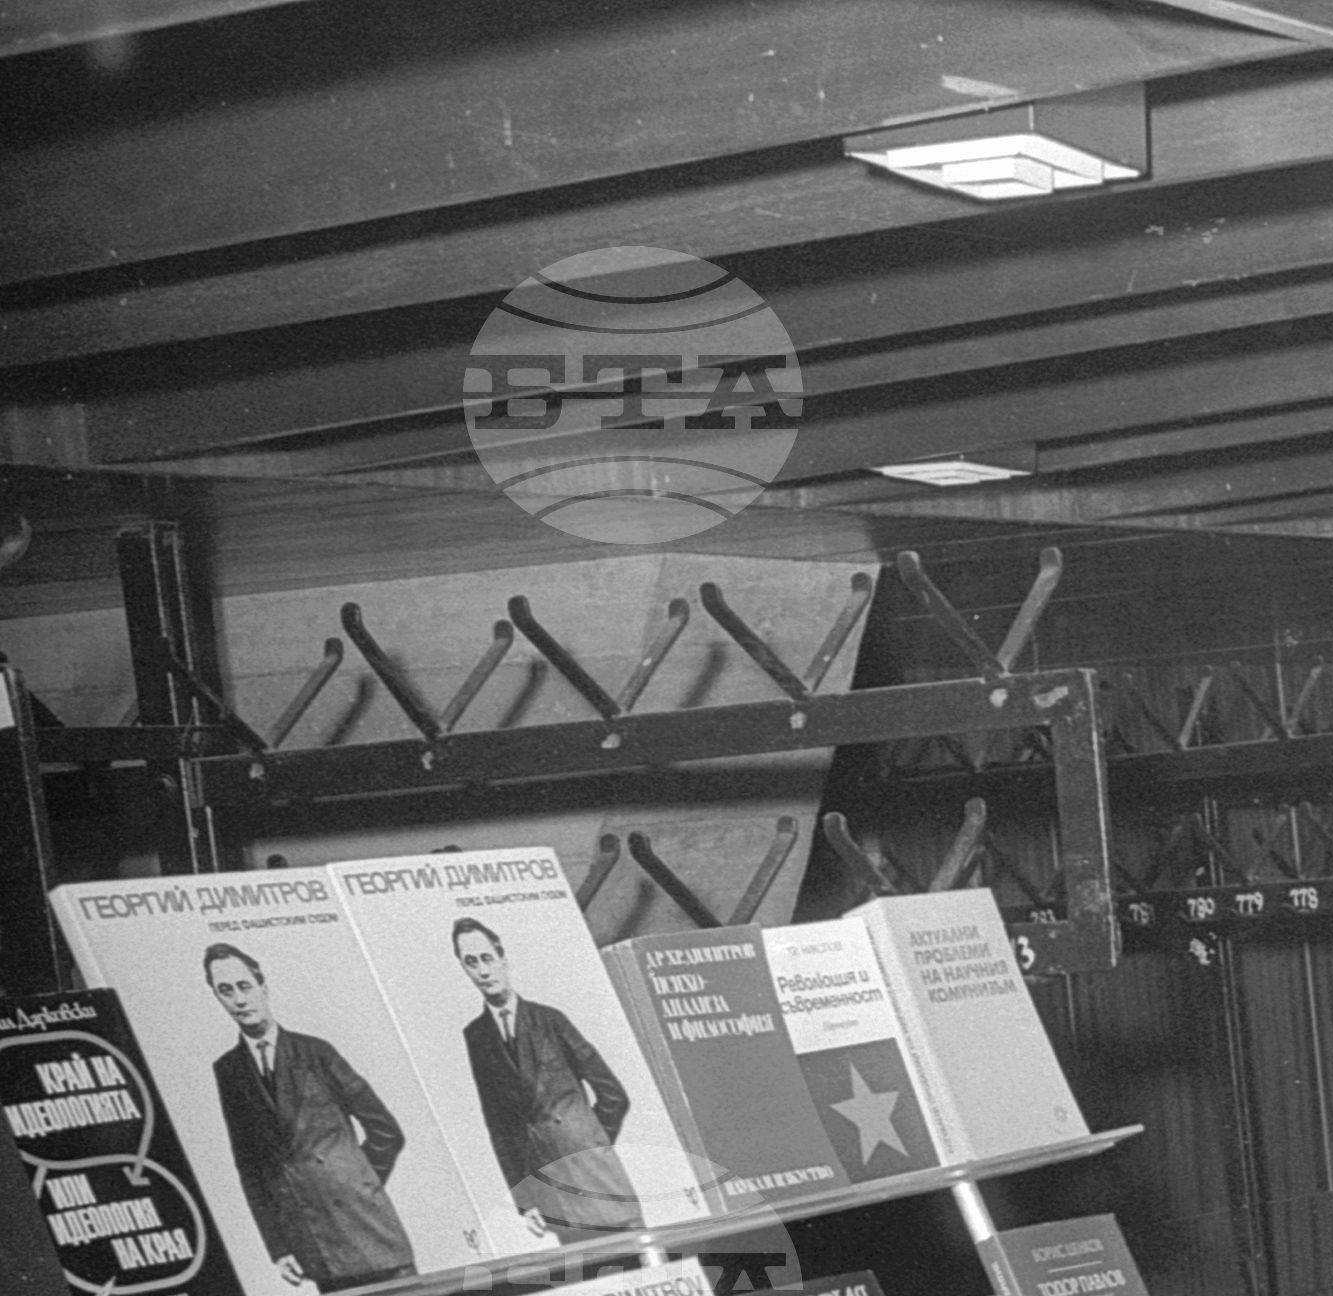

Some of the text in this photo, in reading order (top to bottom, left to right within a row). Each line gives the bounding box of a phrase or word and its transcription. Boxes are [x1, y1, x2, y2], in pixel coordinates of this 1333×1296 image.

[342, 857, 560, 896] ГЕОРГИЙ ДИМИТРОВ
[78, 879, 329, 921] ГЕОРГИЙ ДИМИТРОВ
[1235, 892, 1264, 917] 779
[1289, 888, 1319, 910] 778
[914, 942, 991, 967] ПРОБЛЕМИ
[778, 970, 857, 995] Революция
[920, 968, 945, 986] НА
[34, 1051, 128, 1095] КРАЙ НА
[2, 1089, 142, 1139] ИДЕОЛОГИЯТА
[45, 1172, 98, 1211] ИЛИ
[46, 1197, 163, 1248] ИДЕОЛОГИЯ
[110, 1226, 195, 1272] НА КРАЯ
[1079, 1268, 1128, 1294] ПАВЛОВ
